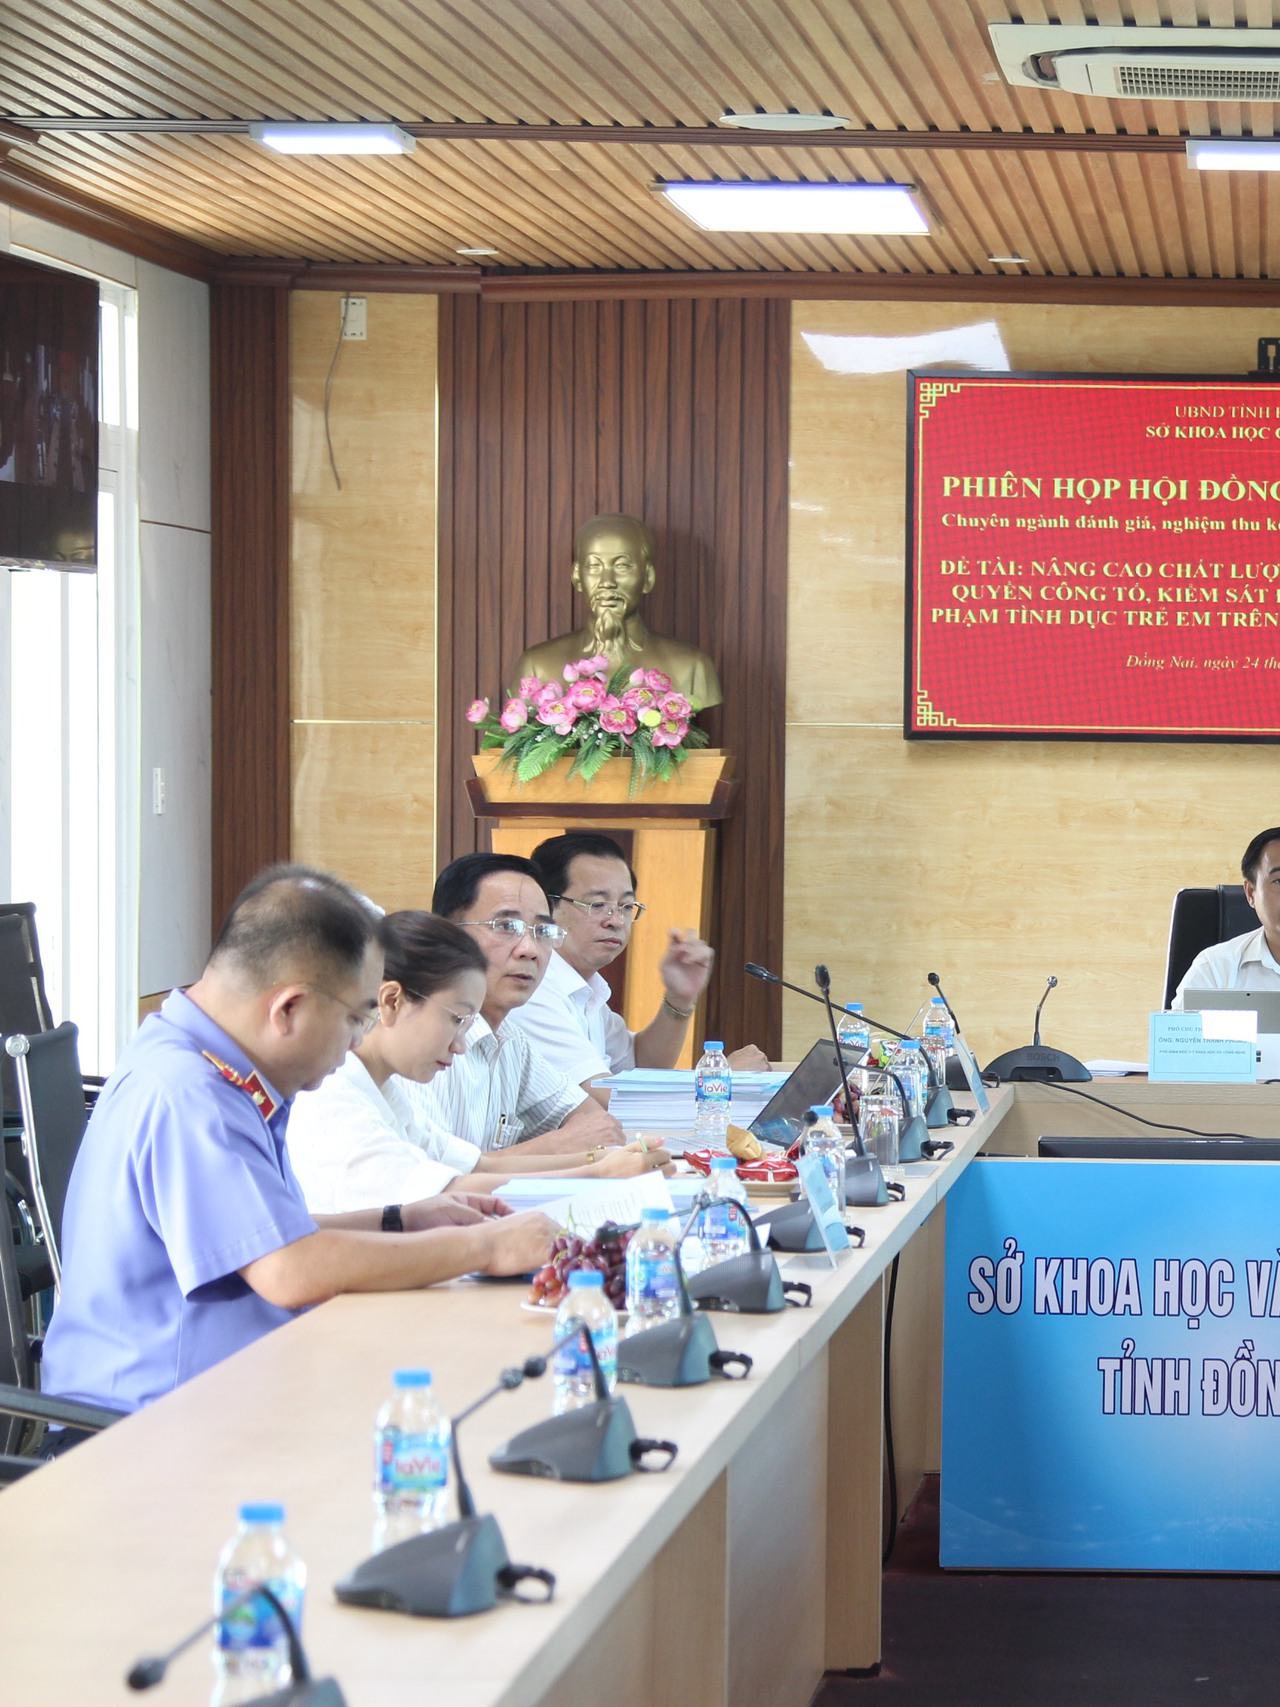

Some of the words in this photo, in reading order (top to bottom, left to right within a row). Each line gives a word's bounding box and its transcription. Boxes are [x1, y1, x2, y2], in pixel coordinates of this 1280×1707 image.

[1175, 405, 1225, 418] UBND
[1174, 427, 1226, 439] KHOA
[1231, 427, 1270, 442] HỌC
[942, 471, 1042, 498] PHIÊN
[1053, 477, 1121, 505] HỌP
[1128, 476, 1187, 506] HỘI
[941, 512, 1010, 531] Chuyên
[1016, 514, 1069, 531] ngành
[1075, 514, 1119, 529] đánh
[1125, 515, 1156, 532] giá,
[1162, 516, 1225, 533] nghiệm
[1231, 517, 1260, 531] thu
[977, 556, 1022, 576] TÀI:
[1031, 557, 1096, 577] NÂNG
[1103, 562, 1152, 578] CAO
[1159, 559, 1224, 579] CHẤT
[952, 581, 1032, 602] QUYỀN
[1040, 581, 1106, 601] CÔNG
[1158, 583, 1218, 603] KIỂM
[1226, 584, 1268, 603] SÁT
[932, 608, 998, 627] PHẠM
[1005, 605, 1061, 625] TÌNH
[1069, 610, 1117, 629] DỤC
[1124, 607, 1169, 626] TRẺ
[1176, 612, 1210, 626] EM
[1217, 608, 1279, 627] TRÊN
[1126, 652, 1164, 670] Đồng
[1203, 656, 1238, 670] ngày
[1242, 656, 1259, 669] 24
[967, 1236, 1025, 1315] SỞ
[1033, 1257, 1143, 1317] KHOA
[1153, 1258, 1235, 1329] HỌC
[1097, 1338, 1191, 1416] TỈNH
